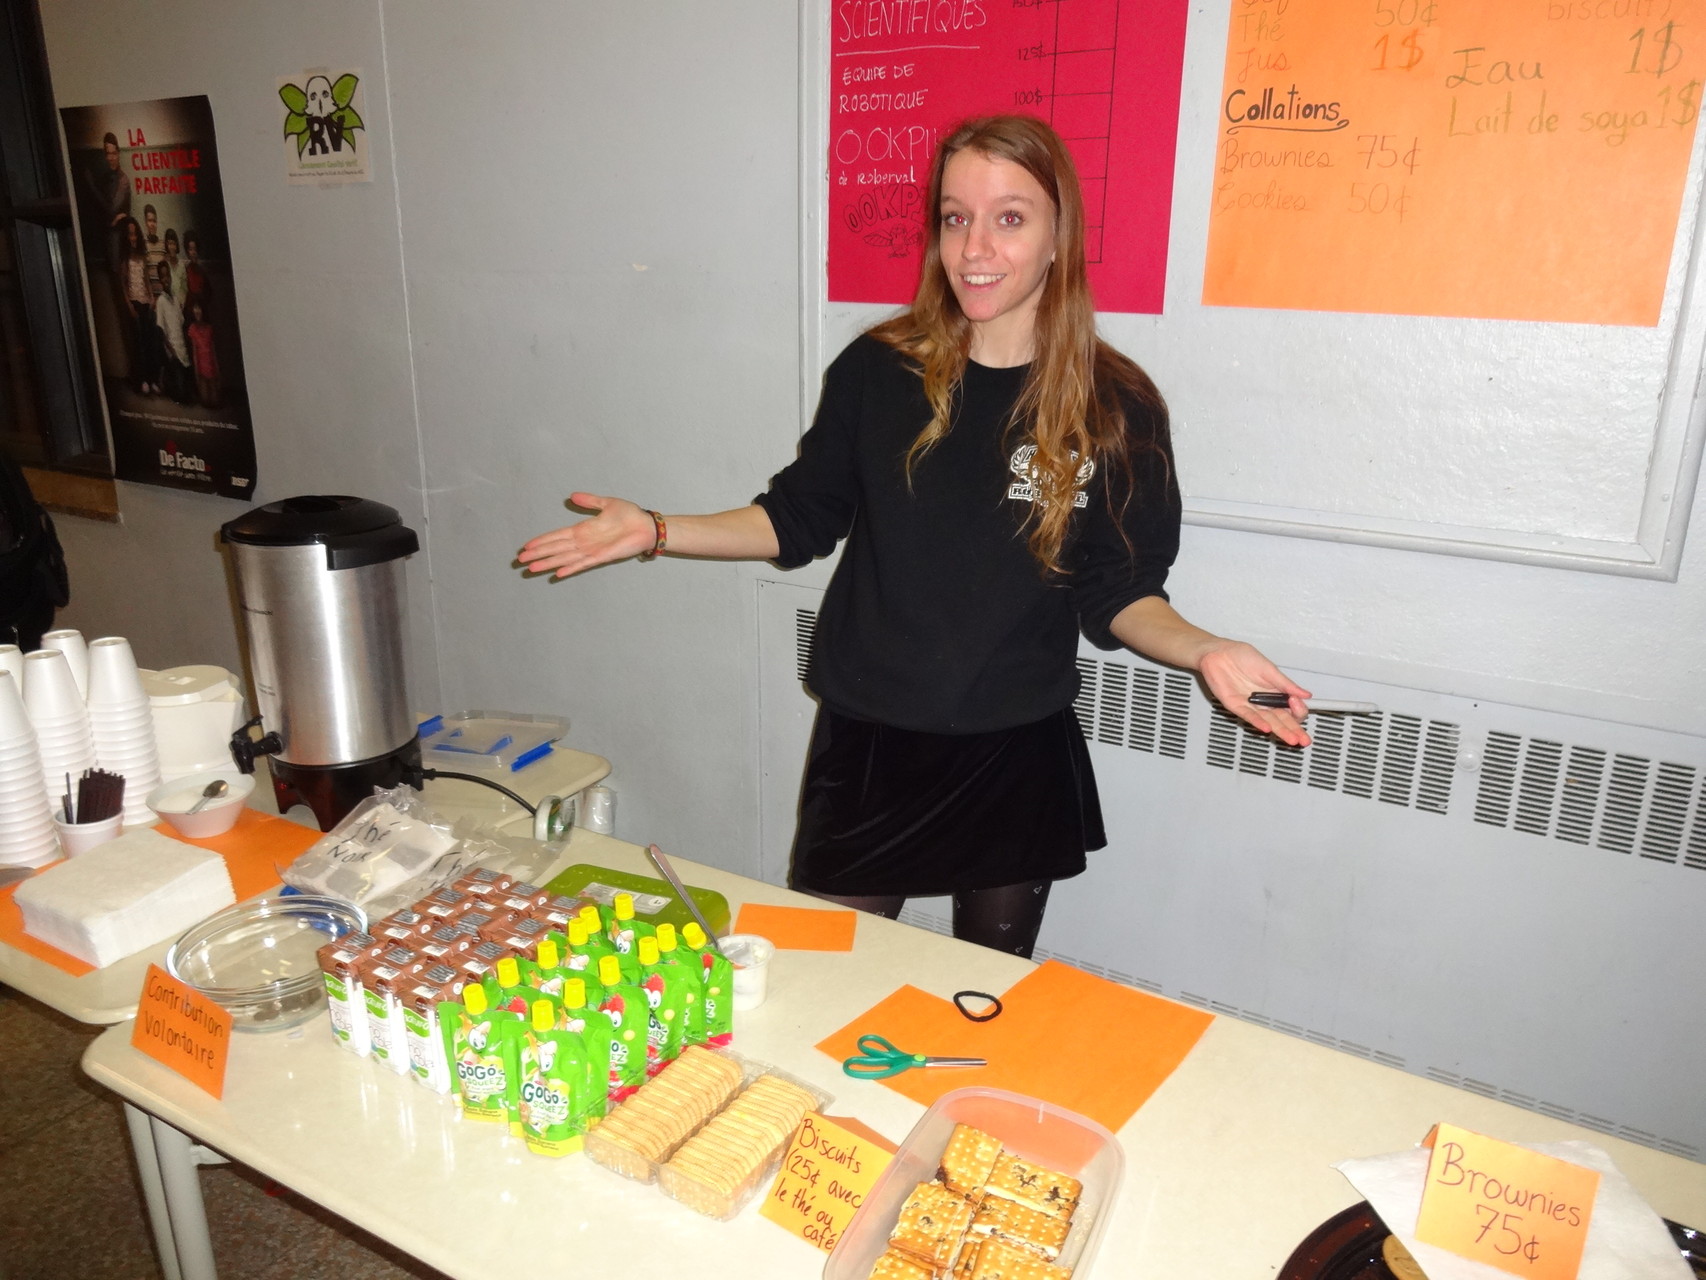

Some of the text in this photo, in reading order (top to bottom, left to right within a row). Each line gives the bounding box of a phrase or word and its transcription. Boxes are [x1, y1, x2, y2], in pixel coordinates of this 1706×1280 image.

[839, 0, 987, 42] SCIENTIFIQUES
[1237, 10, 1286, 42] Thé
[893, 63, 915, 79] DE
[1236, 47, 1292, 83] Jus
[1445, 46, 1545, 89] Eau
[839, 88, 929, 114] ROBOTIQUE
[1225, 84, 1341, 123] Collations
[1448, 90, 1514, 138] Lait
[1527, 89, 1560, 135] de
[1579, 109, 1648, 147] soya
[128, 127, 146, 147] LA
[306, 114, 345, 155] RV
[1220, 135, 1421, 176] Brownies 75¢
[134, 172, 197, 195] PARFAITE
[1215, 179, 1313, 216] Cookies
[159, 449, 206, 472] De Facto
[148, 975, 223, 1037] Contribution
[144, 1010, 215, 1070] Volontaire
[800, 1118, 862, 1174] Biscuits
[775, 1177, 788, 1202] le
[792, 1188, 817, 1216] thé
[828, 1179, 862, 1209] avec
[1437, 1142, 1581, 1228] Brownies
[1475, 1203, 1540, 1265] 75¢
